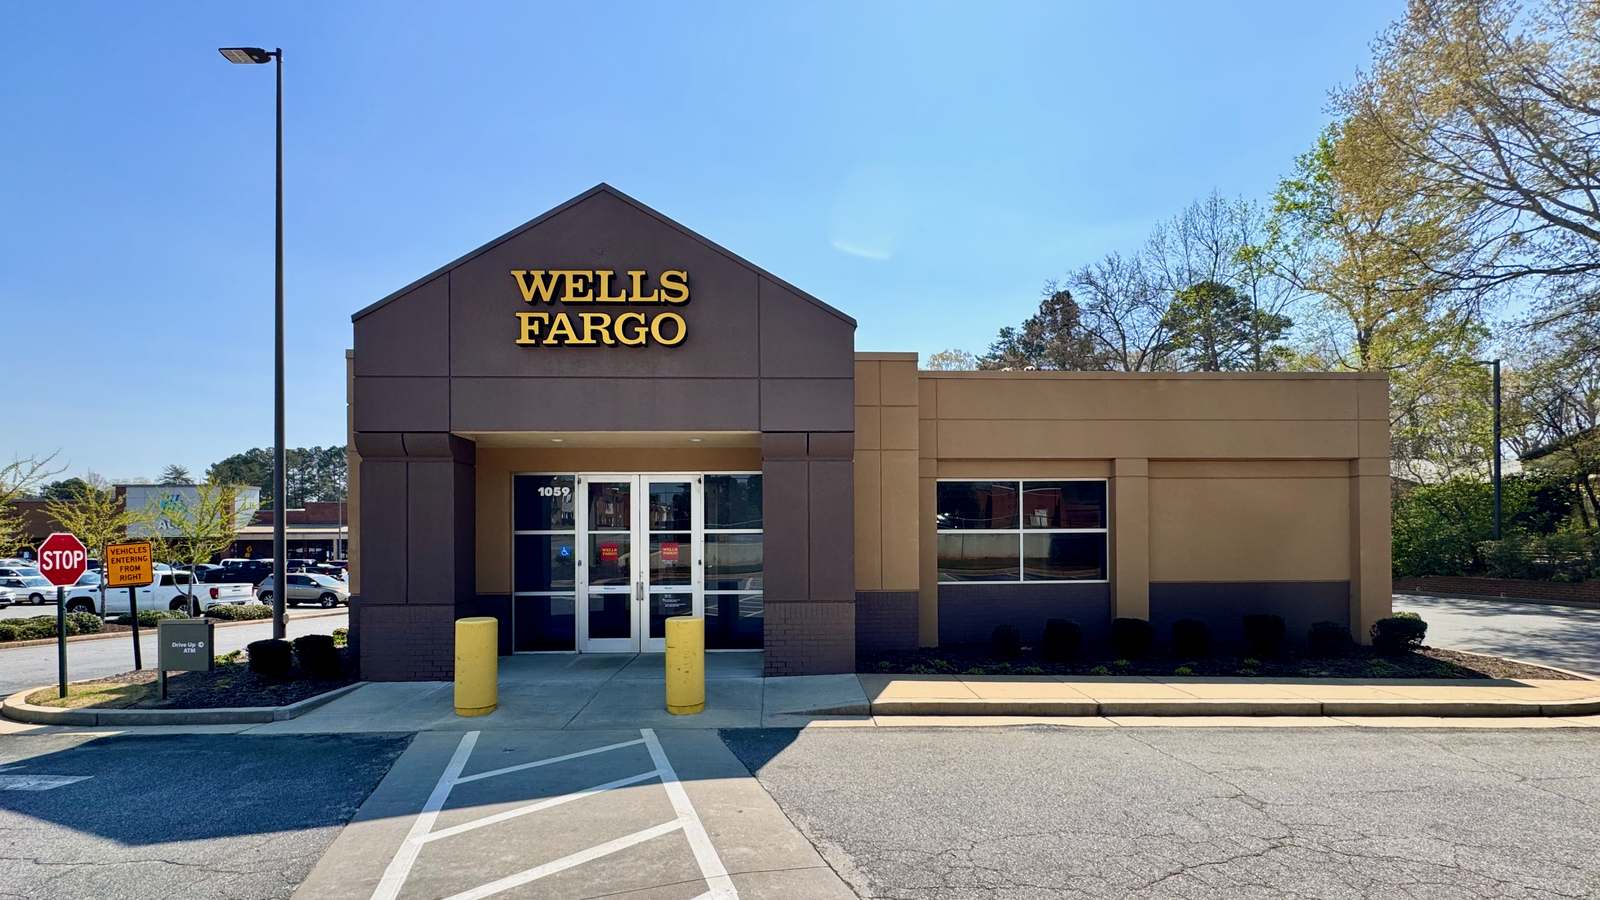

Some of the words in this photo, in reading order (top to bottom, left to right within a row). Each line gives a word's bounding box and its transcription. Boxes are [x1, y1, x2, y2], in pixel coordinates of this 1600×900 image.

[510, 270, 690, 303] WELLS
[515, 312, 687, 345] FARGO
[537, 486, 570, 497] 1059
[110, 546, 147, 555] VEHICLES
[42, 550, 84, 571] STOP
[111, 555, 148, 564] ENTERING
[119, 565, 141, 573] FROM
[119, 574, 142, 582] RIGHT
